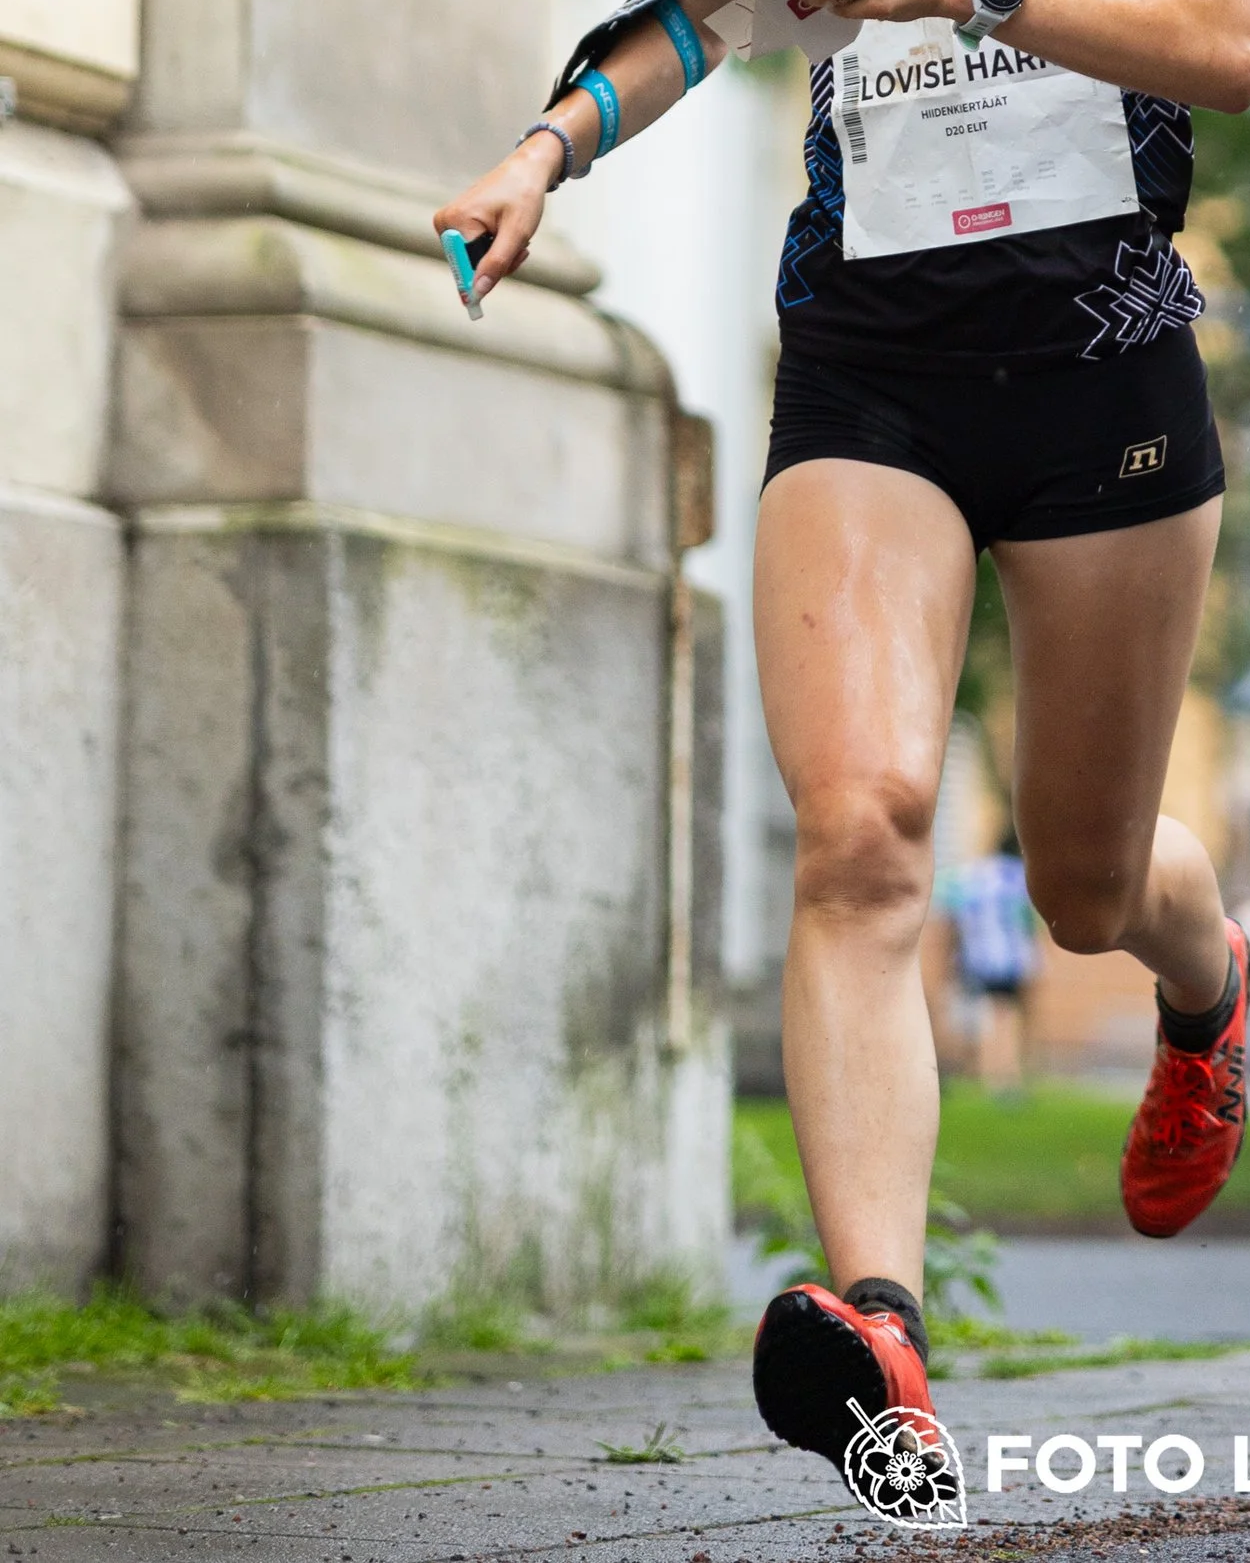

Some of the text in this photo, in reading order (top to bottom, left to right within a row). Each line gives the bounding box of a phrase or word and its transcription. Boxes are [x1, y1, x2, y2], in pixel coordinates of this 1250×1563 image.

[861, 57, 956, 101] LOVISE
[921, 96, 1008, 120] HIIDENKIERTÄJÄT
[945, 121, 988, 137] D20 ELIT
